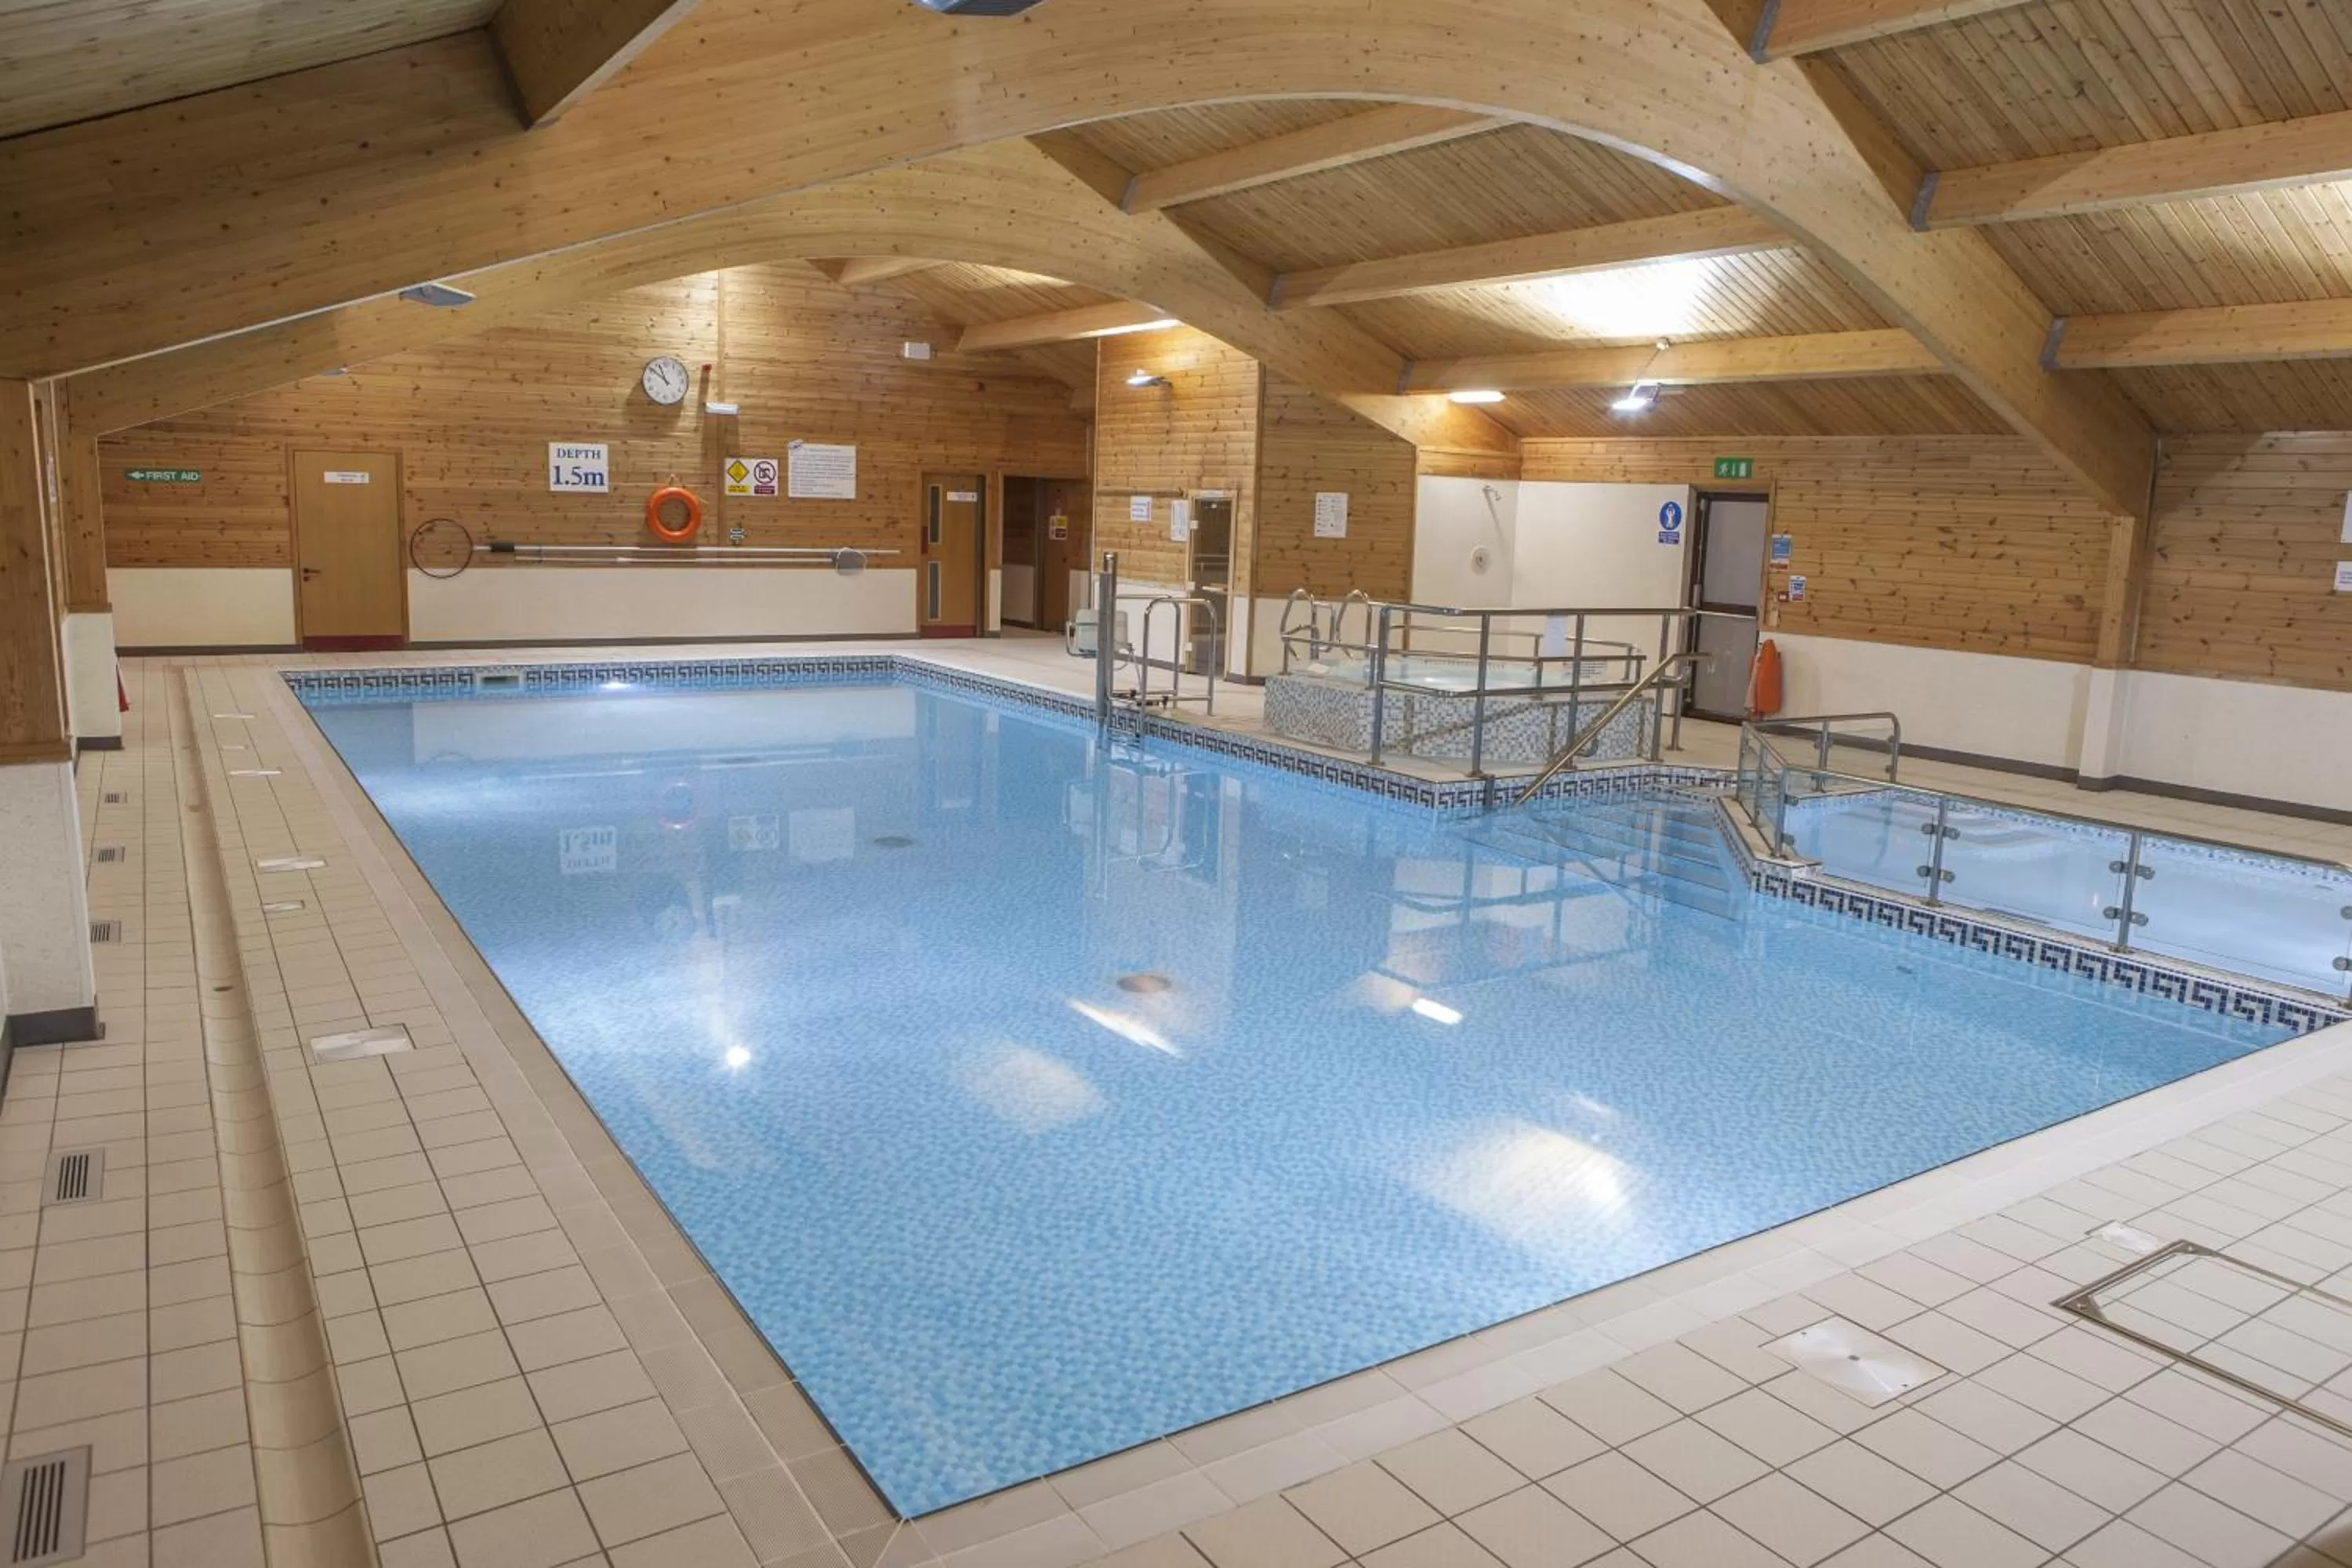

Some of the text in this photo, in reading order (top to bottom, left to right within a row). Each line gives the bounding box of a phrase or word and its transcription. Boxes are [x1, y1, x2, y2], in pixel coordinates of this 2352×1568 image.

[556, 448, 601, 459] DEPTH
[145, 471, 198, 481] FIRST AID
[553, 465, 604, 486] 1.5m
